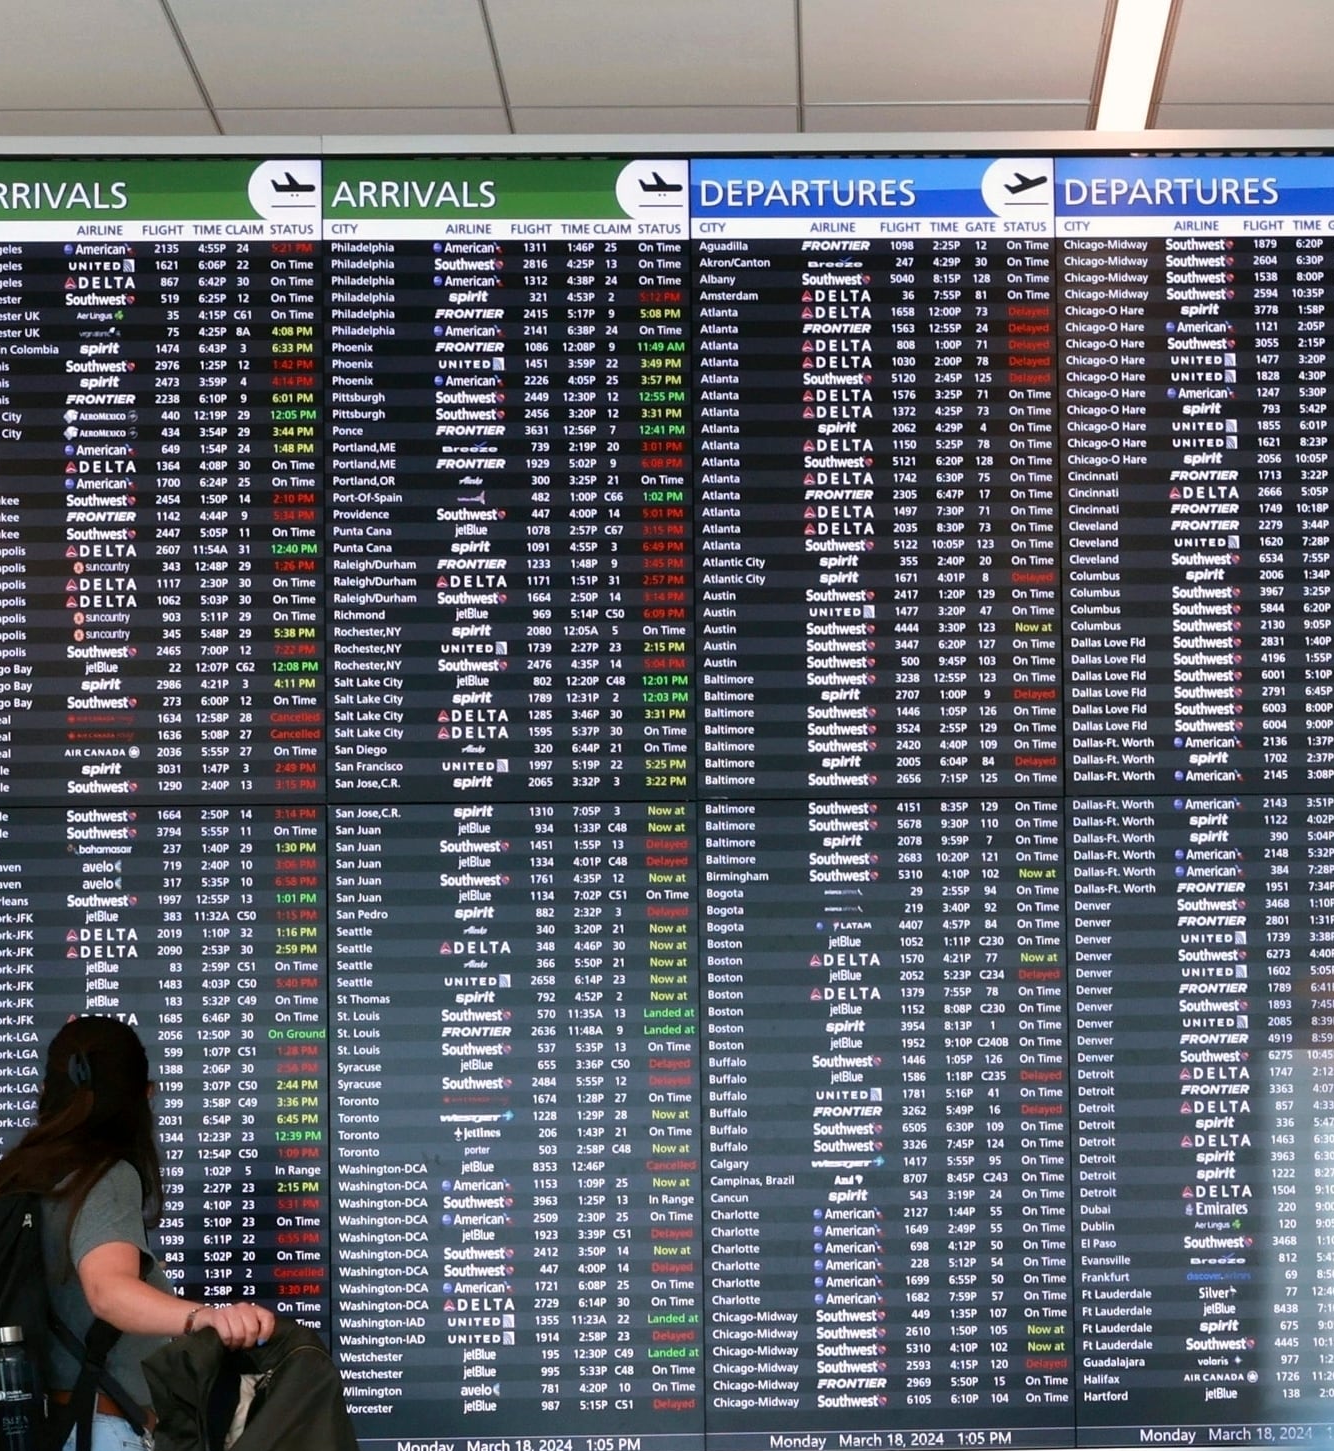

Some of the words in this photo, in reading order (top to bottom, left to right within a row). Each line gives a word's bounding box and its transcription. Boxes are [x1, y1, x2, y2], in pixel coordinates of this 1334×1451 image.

[331, 181, 495, 207] ARRIVALS
[701, 179, 915, 206] DEPARTURES
[1065, 178, 1277, 204] DEPARTURES
[700, 223, 725, 232] CITY
[810, 222, 855, 232] AIRLINE
[881, 222, 921, 232] FLIGHT
[930, 222, 958, 232] TIME
[965, 222, 995, 232] GATE
[1004, 222, 1046, 232] STATUS
[700, 258, 770, 267] Akron/Canton
[896, 257, 913, 267] 247
[933, 257, 960, 266] 4:29P
[975, 257, 987, 266] 30
[1007, 257, 1022, 266] On
[1025, 257, 1049, 266] Time
[1065, 273, 1148, 284] Chicago-Midway
[1166, 271, 1229, 283] Southwest
[1255, 272, 1278, 281] 1538
[1297, 272, 1324, 281] 8:00P
[332, 309, 395, 320] Philadelphia
[524, 309, 548, 318] 2415
[568, 309, 595, 318] 5:17P
[608, 309, 615, 318] 9
[641, 309, 661, 318] 5:08
[665, 309, 680, 318] PM
[2, 412, 22, 423] City
[161, 411, 180, 420] 440
[195, 411, 227, 420] 12:19P
[238, 411, 250, 420] 29
[271, 410, 297, 419] 12:05
[300, 410, 316, 419] PM
[337, 944, 372, 953] Seattle
[454, 941, 510, 954] DELTA
[537, 942, 555, 951] 348
[574, 941, 602, 951] 4:46P
[613, 941, 625, 950] 30
[650, 941, 673, 950] Now
[676, 941, 686, 949] at
[711, 1176, 762, 1187] Campinas,
[766, 1175, 794, 1185] Brazil
[903, 1174, 927, 1183] 8707
[947, 1173, 975, 1182] 8:45P
[983, 1173, 1008, 1182] C243
[1022, 1172, 1037, 1181] On
[1040, 1172, 1064, 1181] Time
[1081, 1205, 1110, 1214] Dubai
[1196, 1202, 1247, 1215] Emirates
[1278, 1202, 1296, 1211] 220
[539, 1439, 572, 1451] 2024
[587, 1439, 613, 1451] 1:05
[619, 1438, 640, 1450] PM
